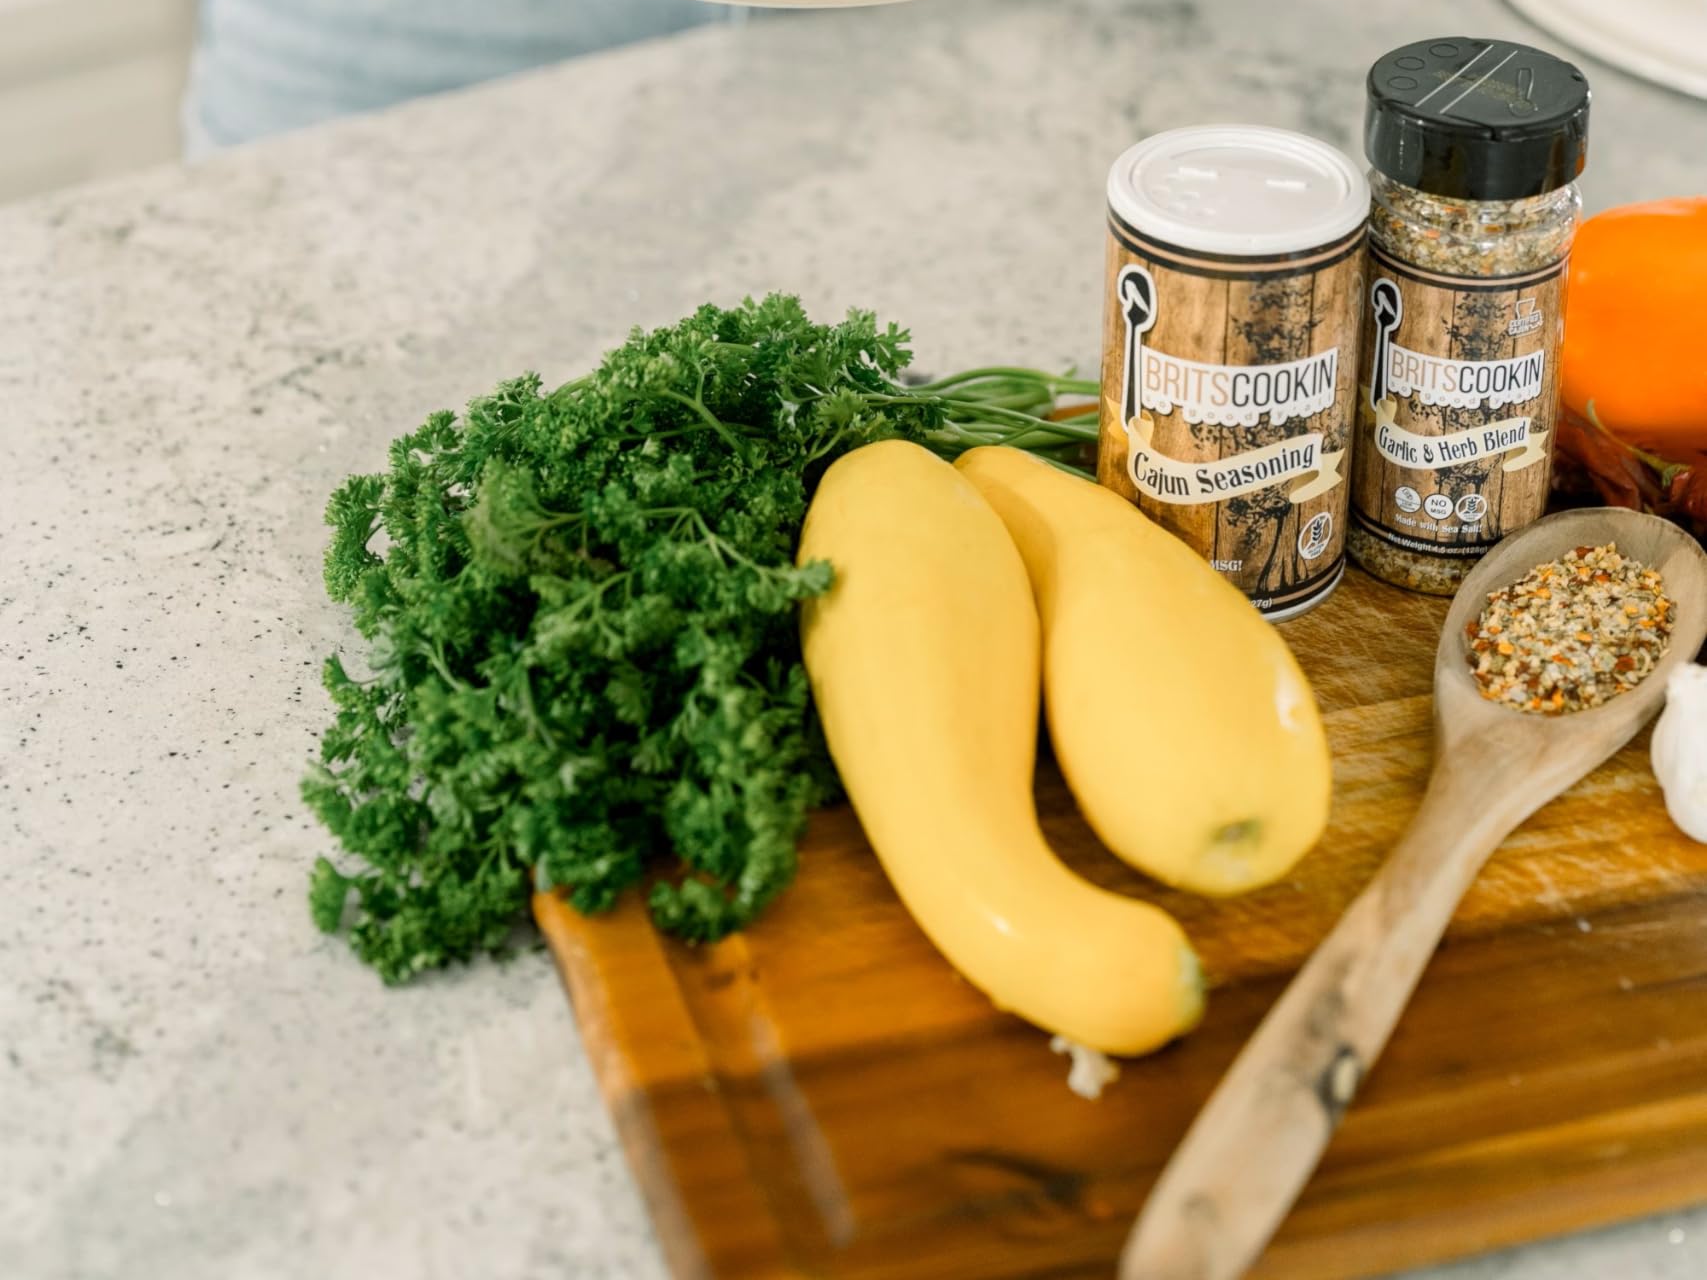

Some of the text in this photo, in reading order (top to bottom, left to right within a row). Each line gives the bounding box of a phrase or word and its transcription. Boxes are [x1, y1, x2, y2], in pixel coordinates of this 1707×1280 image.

[1146, 355, 1334, 407] BRITSCOOKIN
[1391, 349, 1541, 393] BRITSCOOKIN
[1379, 421, 1526, 464] Garlic & Herb Blend
[1134, 443, 1315, 495] Cajun Seasoning
[1431, 499, 1447, 507] NO
[1394, 513, 1482, 533] Made with Sea Salt!
[1387, 533, 1401, 544] Net
[1401, 538, 1431, 552] Weight
[1249, 597, 1273, 609] 27g)
